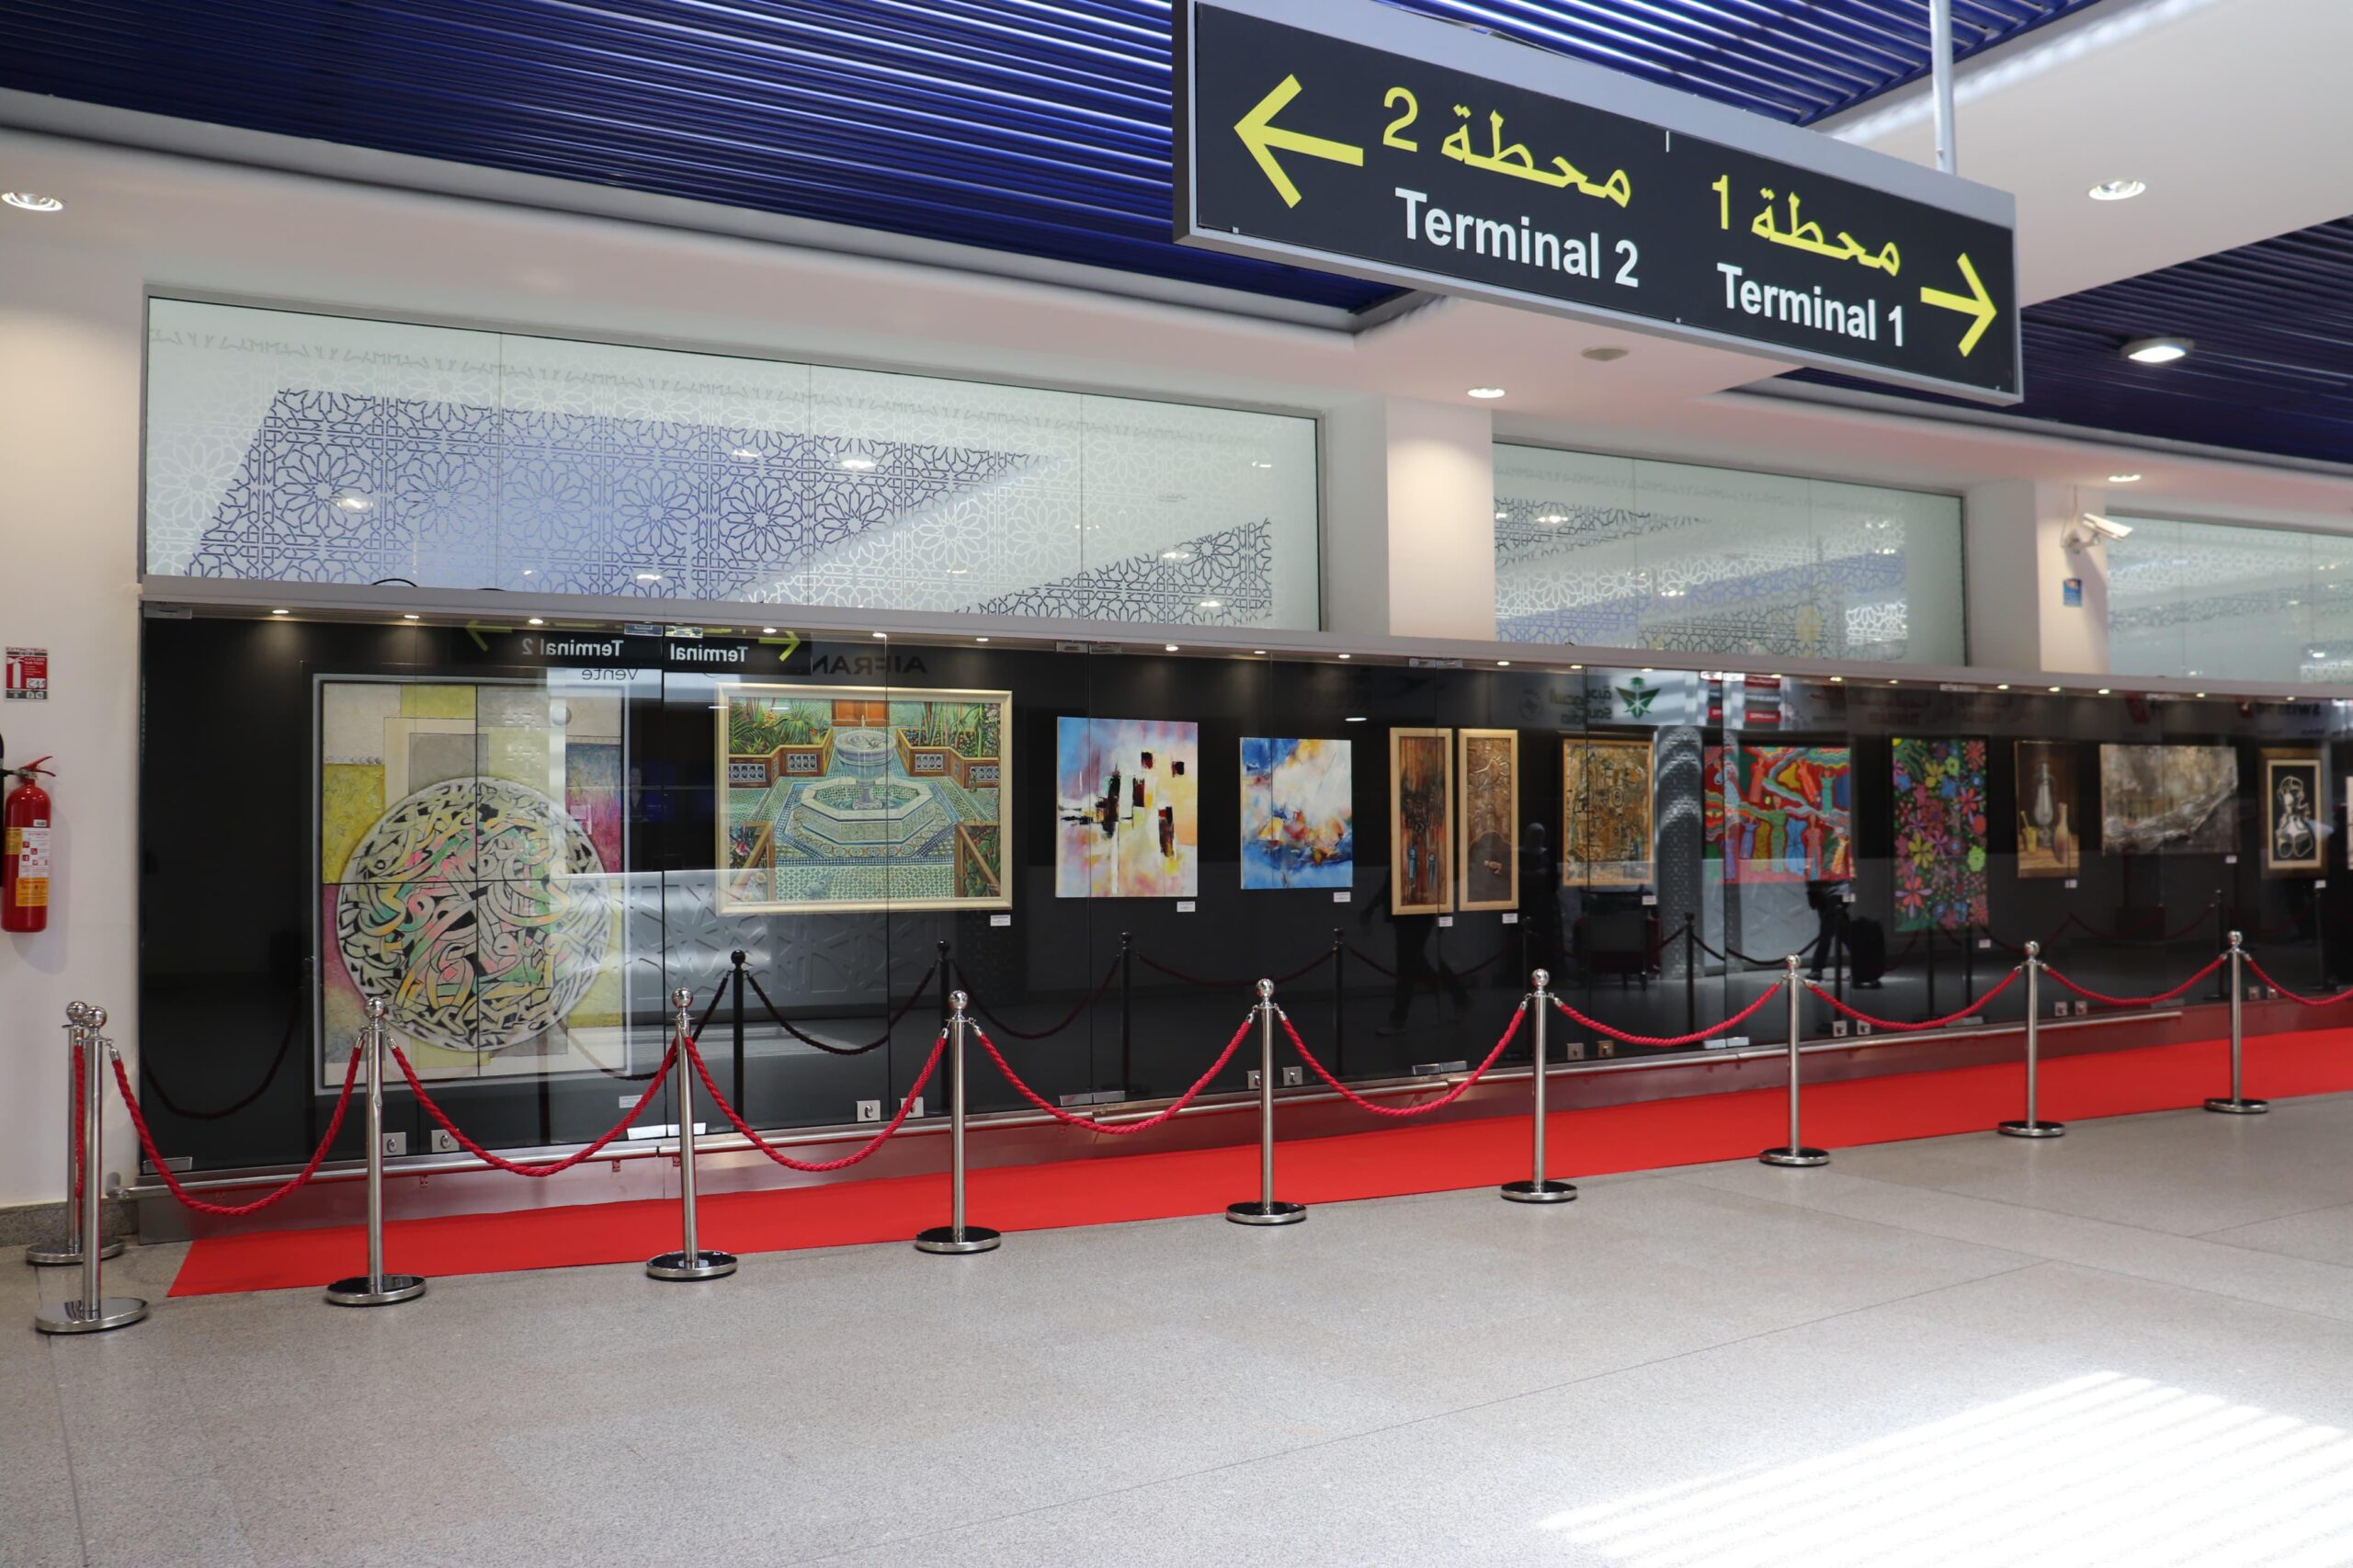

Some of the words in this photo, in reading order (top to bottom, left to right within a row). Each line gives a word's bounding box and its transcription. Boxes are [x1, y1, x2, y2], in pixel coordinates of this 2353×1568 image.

[1383, 87, 1418, 152] 2
[1442, 105, 1631, 207] محطة
[1395, 187, 1600, 278] Terminal
[1615, 240, 1639, 288] 2
[1713, 176, 1729, 229] 1
[1752, 187, 1901, 276] محطة
[1716, 263, 1877, 341] Terminal
[1888, 305, 1903, 347] 1
